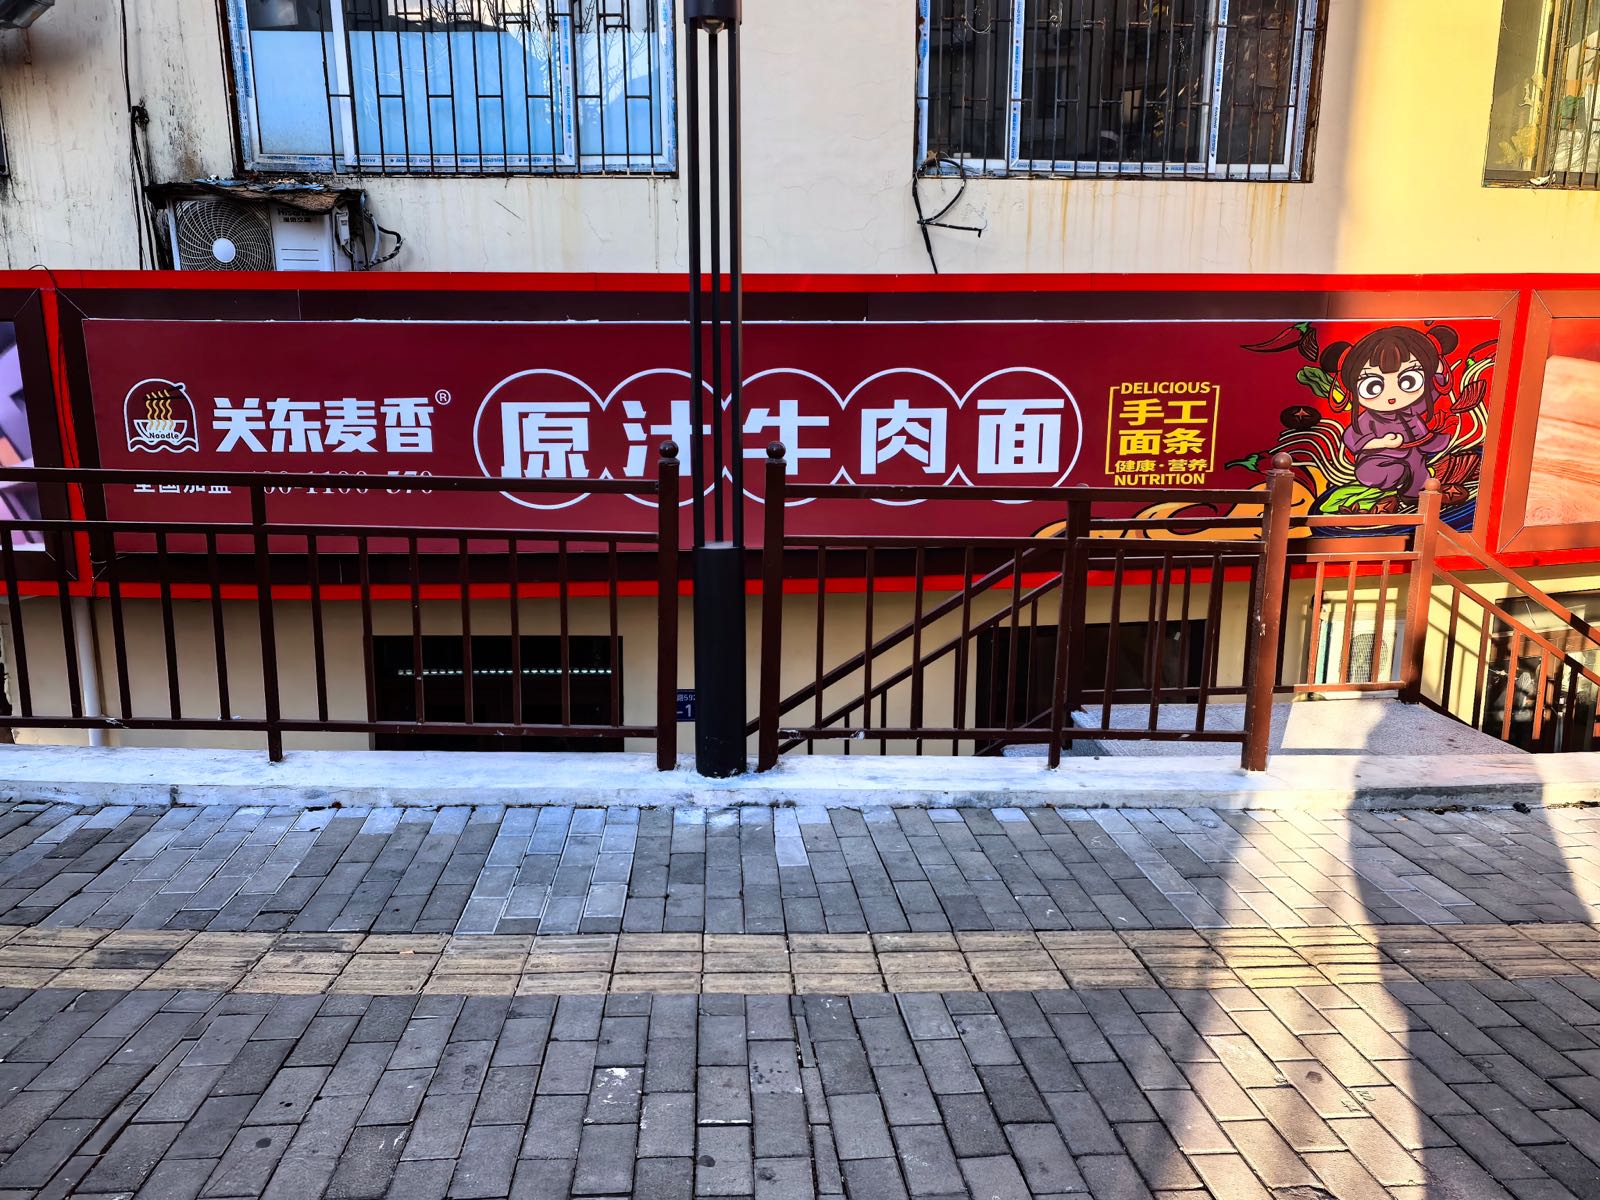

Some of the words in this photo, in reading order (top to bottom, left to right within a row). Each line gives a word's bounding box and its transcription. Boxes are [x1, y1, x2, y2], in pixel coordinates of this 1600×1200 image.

[1120, 381, 1211, 395] DELICIOUS
[212, 397, 435, 453] 关东麦香
[1119, 398, 1208, 426] 手工
[149, 432, 179, 440] Noodle
[501, 399, 1065, 478] 原汁牛肉面
[1118, 427, 1207, 456] 面条
[1113, 473, 1205, 486] NUTRITION
